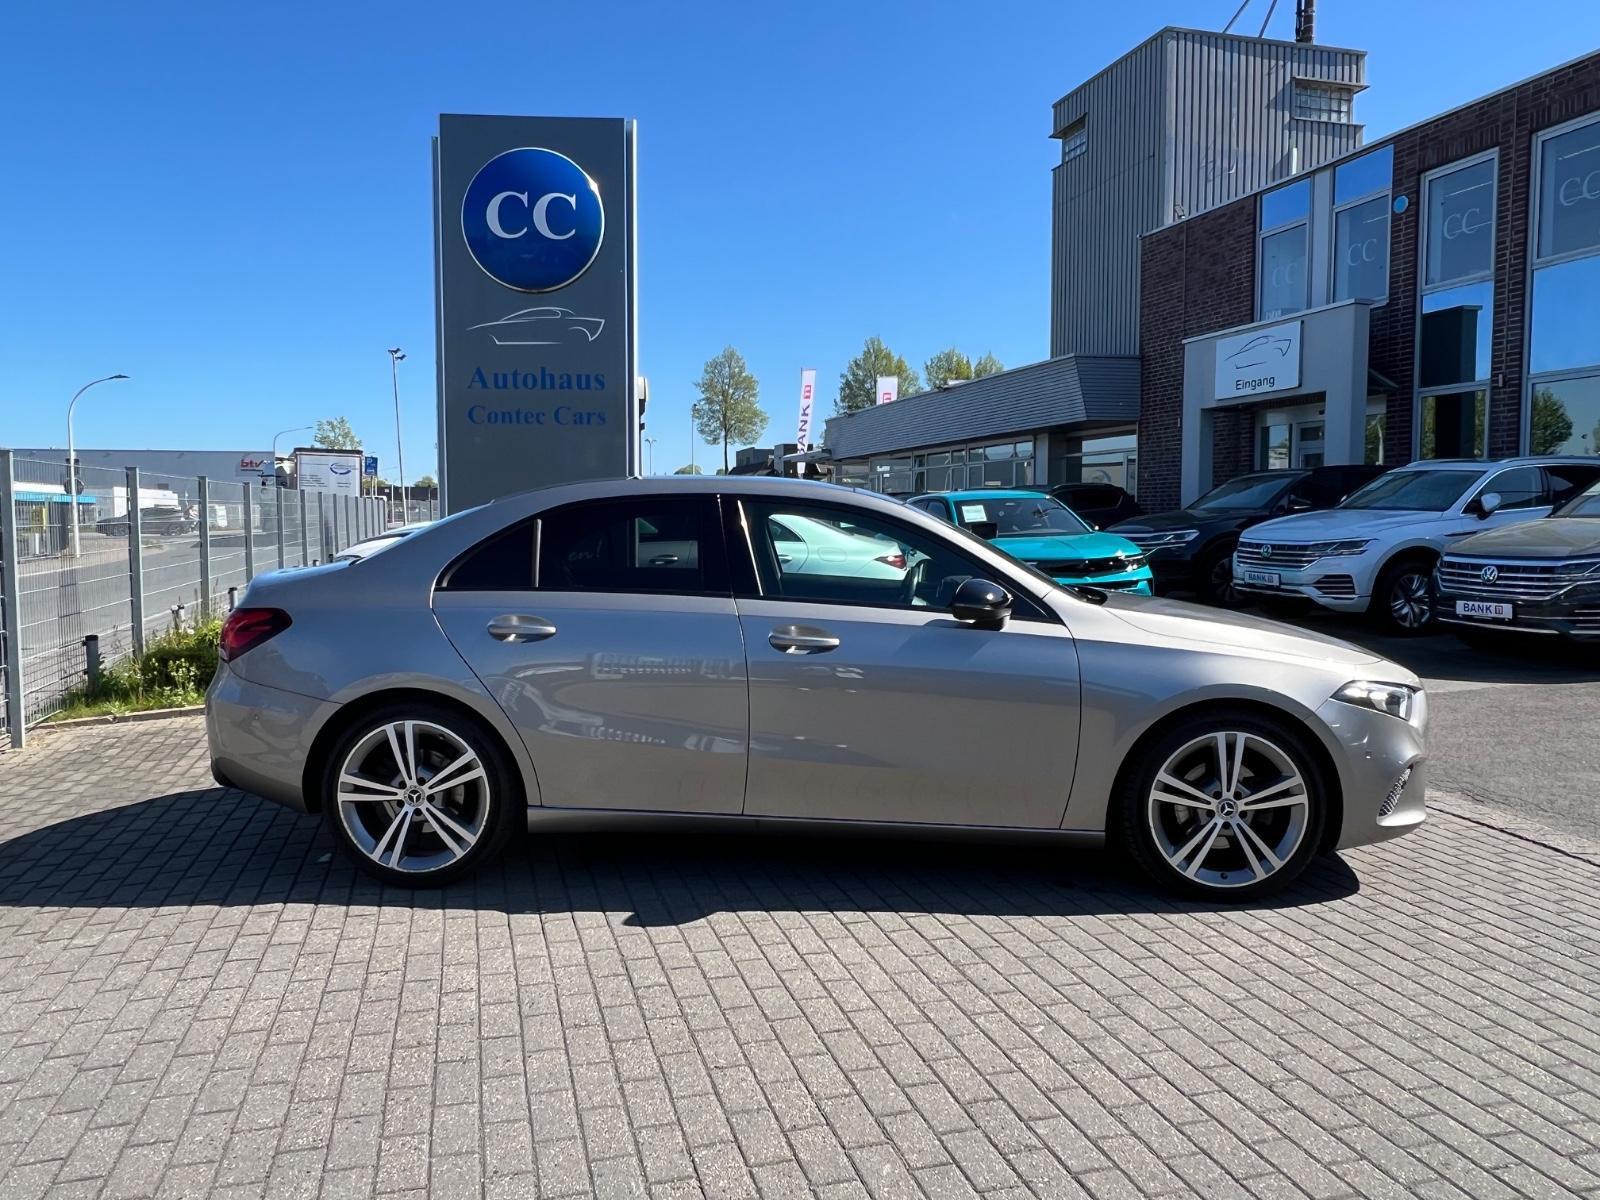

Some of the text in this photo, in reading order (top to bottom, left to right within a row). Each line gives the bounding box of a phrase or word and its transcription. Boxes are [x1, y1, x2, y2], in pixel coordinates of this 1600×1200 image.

[486, 190, 577, 240] CC
[1443, 208, 1480, 240] CC
[467, 366, 606, 392] Autohaus
[1235, 376, 1275, 391] Eingang
[467, 404, 607, 427] Contec Cars
[1463, 603, 1493, 614] BANK
